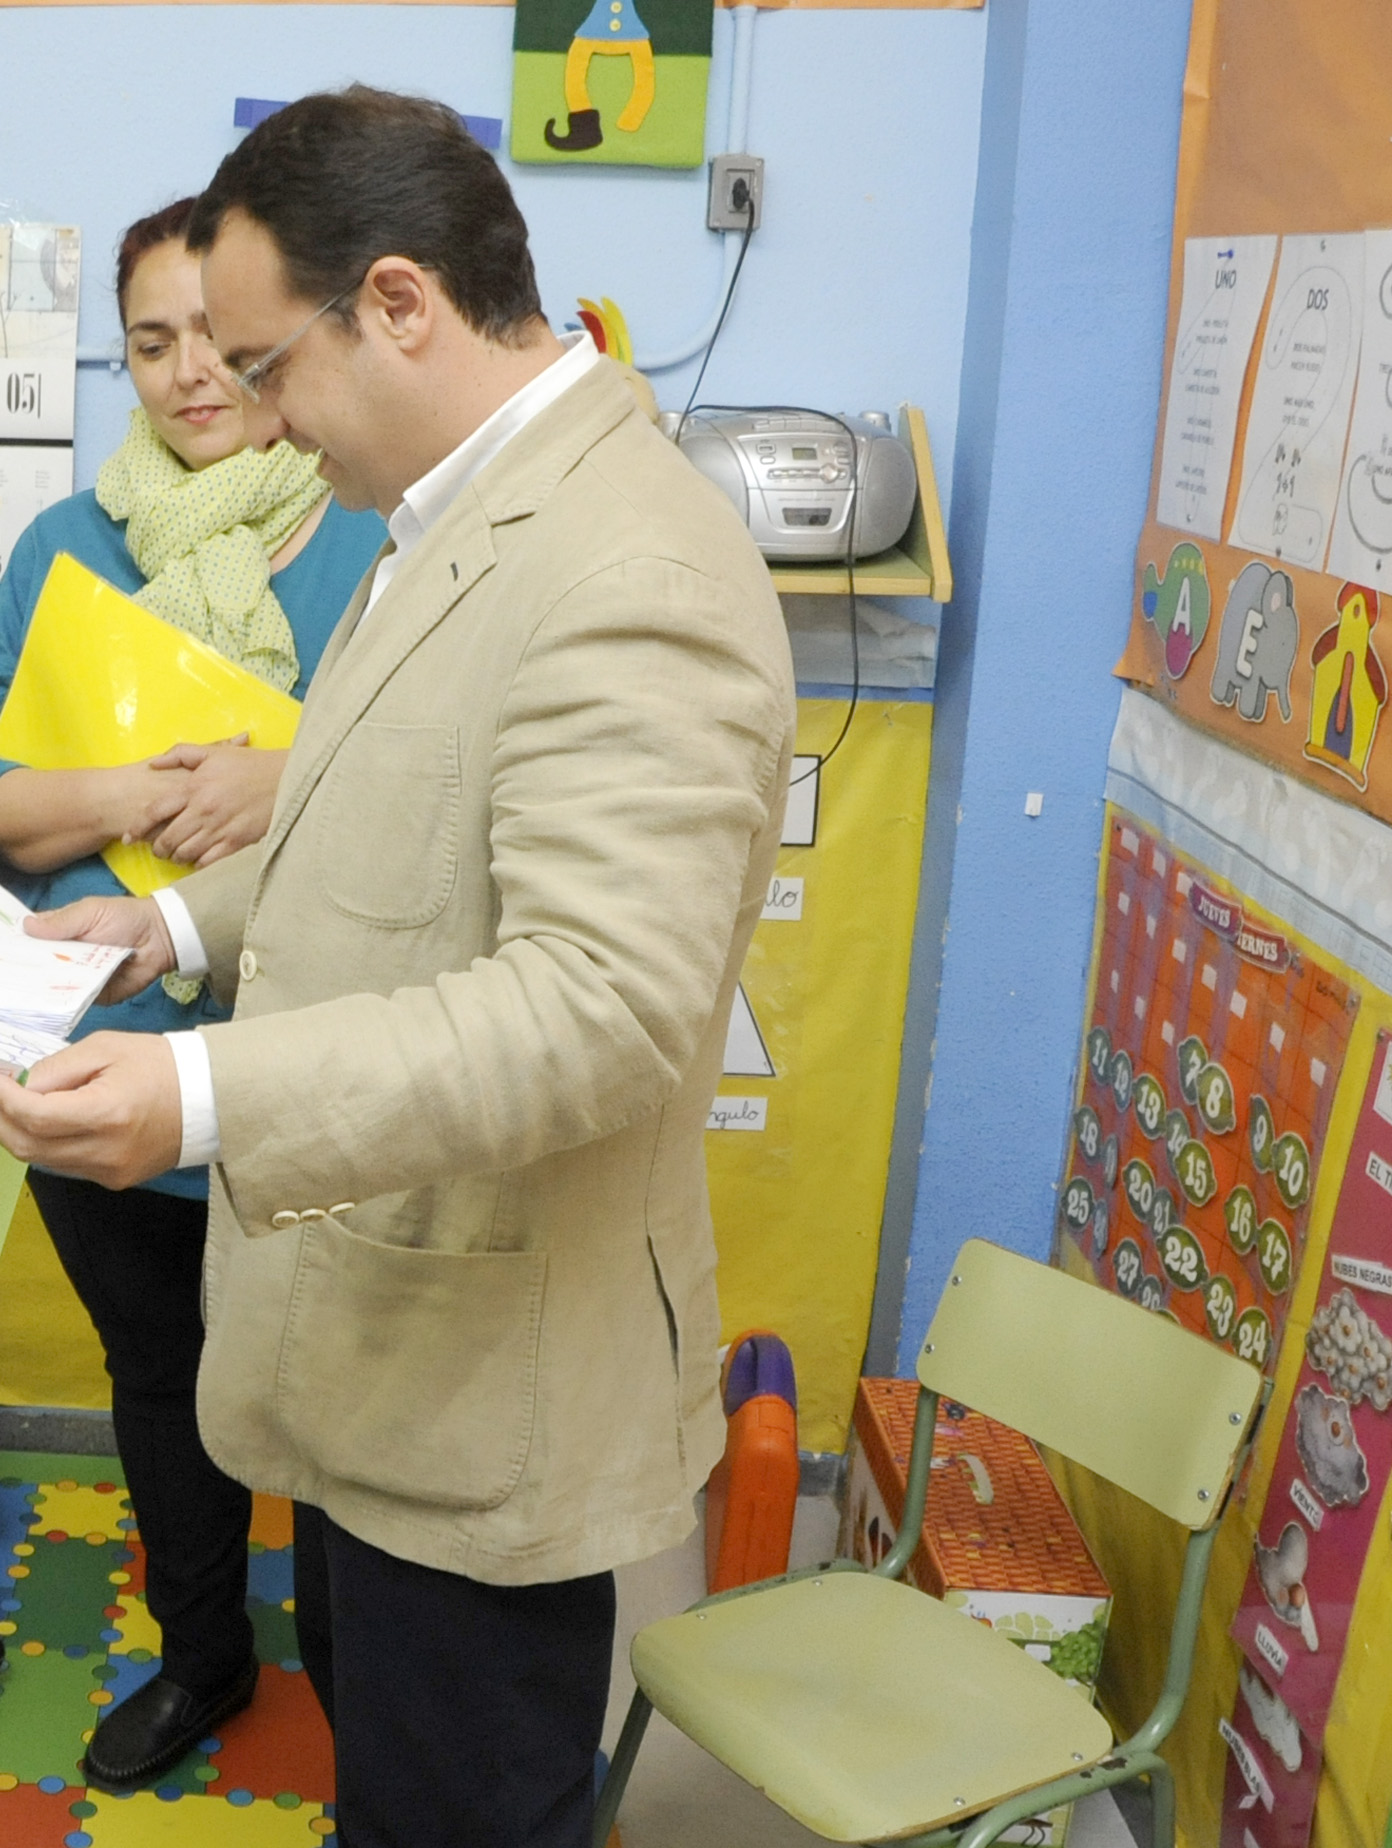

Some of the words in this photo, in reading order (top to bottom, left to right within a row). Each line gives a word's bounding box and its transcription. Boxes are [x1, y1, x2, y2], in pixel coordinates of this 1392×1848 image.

[1214, 269, 1238, 291] UNO
[1306, 287, 1330, 311] DOS
[6, 372, 36, 415] 05
[1171, 576, 1192, 637] A
[1235, 608, 1264, 680] E
[765, 879, 799, 908] lo
[1198, 896, 1231, 929] JUEVES
[1236, 931, 1278, 962] IERNES
[1092, 1037, 1109, 1077] 11
[1137, 1084, 1162, 1130] 13
[1205, 1077, 1225, 1119] 8
[1079, 1115, 1099, 1157] 18
[1253, 1114, 1268, 1154] 9
[1128, 1167, 1153, 1214] 20
[1184, 1151, 1207, 1198] 15
[1279, 1144, 1305, 1198] 10
[1368, 1159, 1383, 1181] EL
[1067, 1187, 1091, 1225] 25
[1153, 1199, 1171, 1234] 21
[1230, 1196, 1253, 1244] 16
[1116, 1249, 1140, 1291] 27
[1164, 1235, 1199, 1283] 22
[1261, 1231, 1288, 1283] 17
[1334, 1261, 1358, 1280] NUBES
[1359, 1267, 1392, 1290] NEGRAS
[1206, 1283, 1235, 1338] 23
[1238, 1320, 1267, 1363] 24
